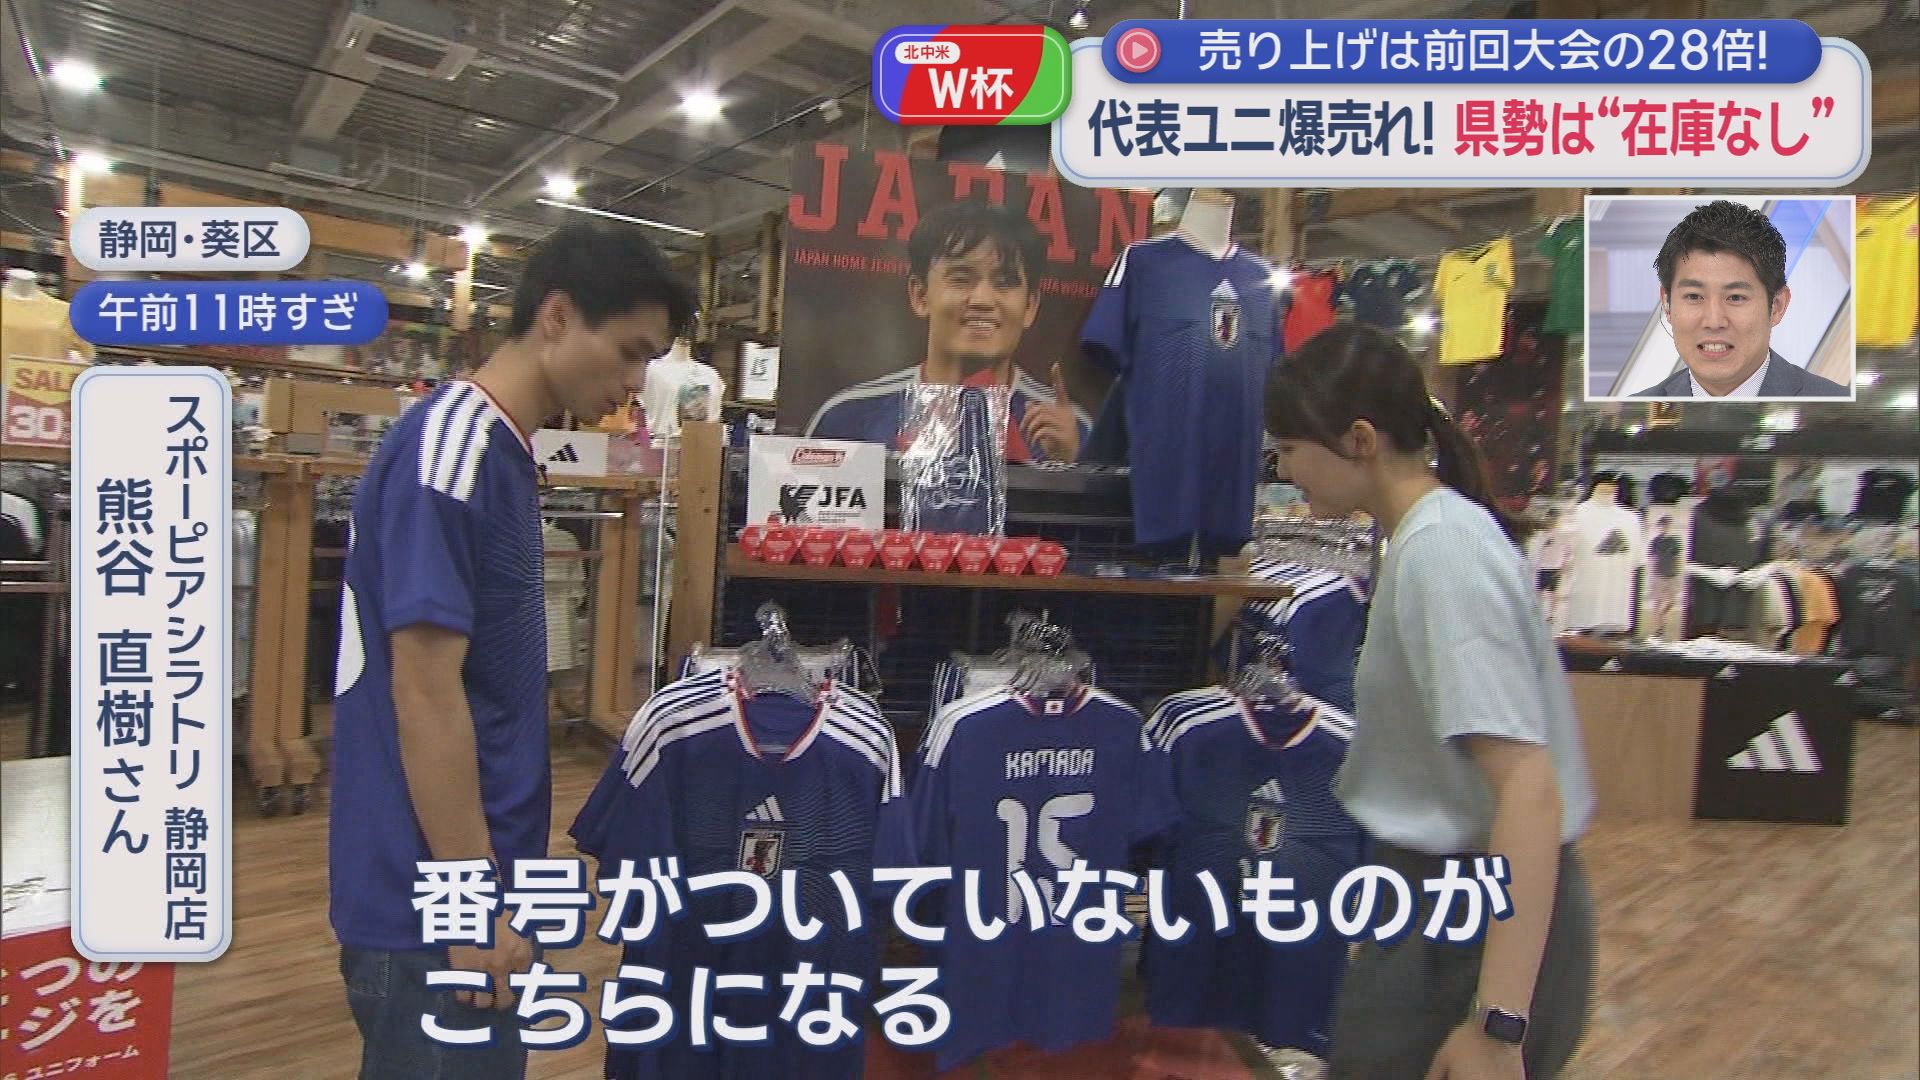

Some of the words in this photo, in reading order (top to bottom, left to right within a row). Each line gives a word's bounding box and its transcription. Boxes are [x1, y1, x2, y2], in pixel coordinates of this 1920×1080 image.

[794, 248, 830, 268] JAPAN
[833, 253, 866, 272] HOME
[818, 486, 867, 509] JFA
[1005, 749, 1096, 780] KAMADA
